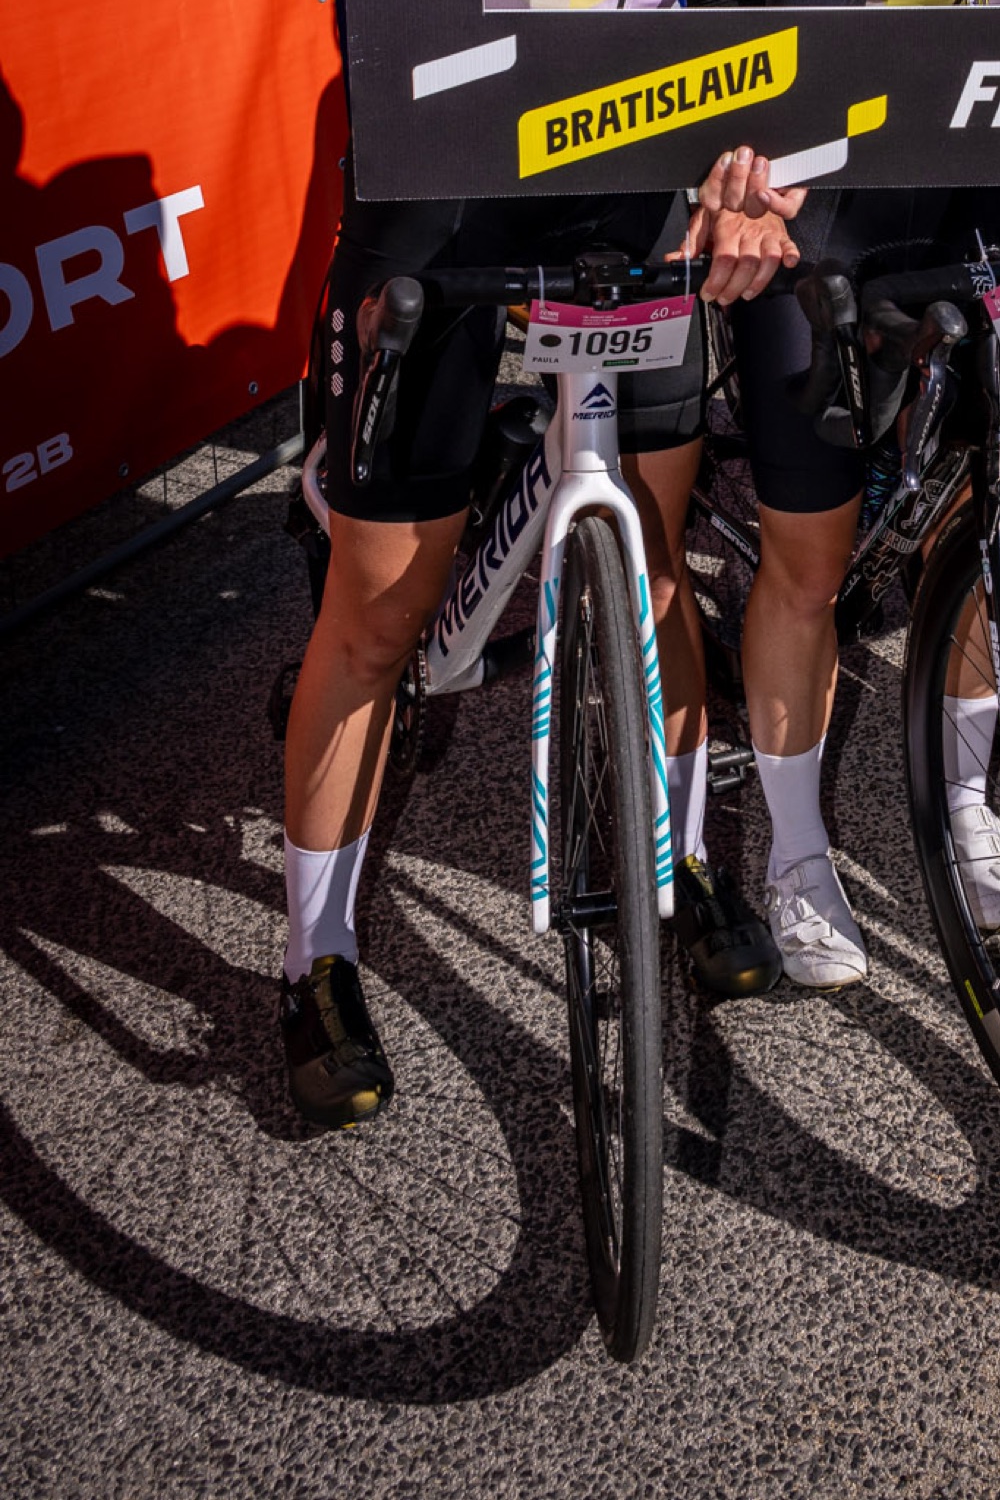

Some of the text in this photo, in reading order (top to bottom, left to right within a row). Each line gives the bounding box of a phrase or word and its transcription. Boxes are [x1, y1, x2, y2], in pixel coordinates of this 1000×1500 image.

[545, 50, 774, 155] BRATISLAVA
[650, 307, 669, 320] 60
[568, 327, 653, 356] 1095
[532, 356, 559, 364] PAULA
[572, 408, 616, 421] MERID
[438, 445, 553, 657] MERIDA
